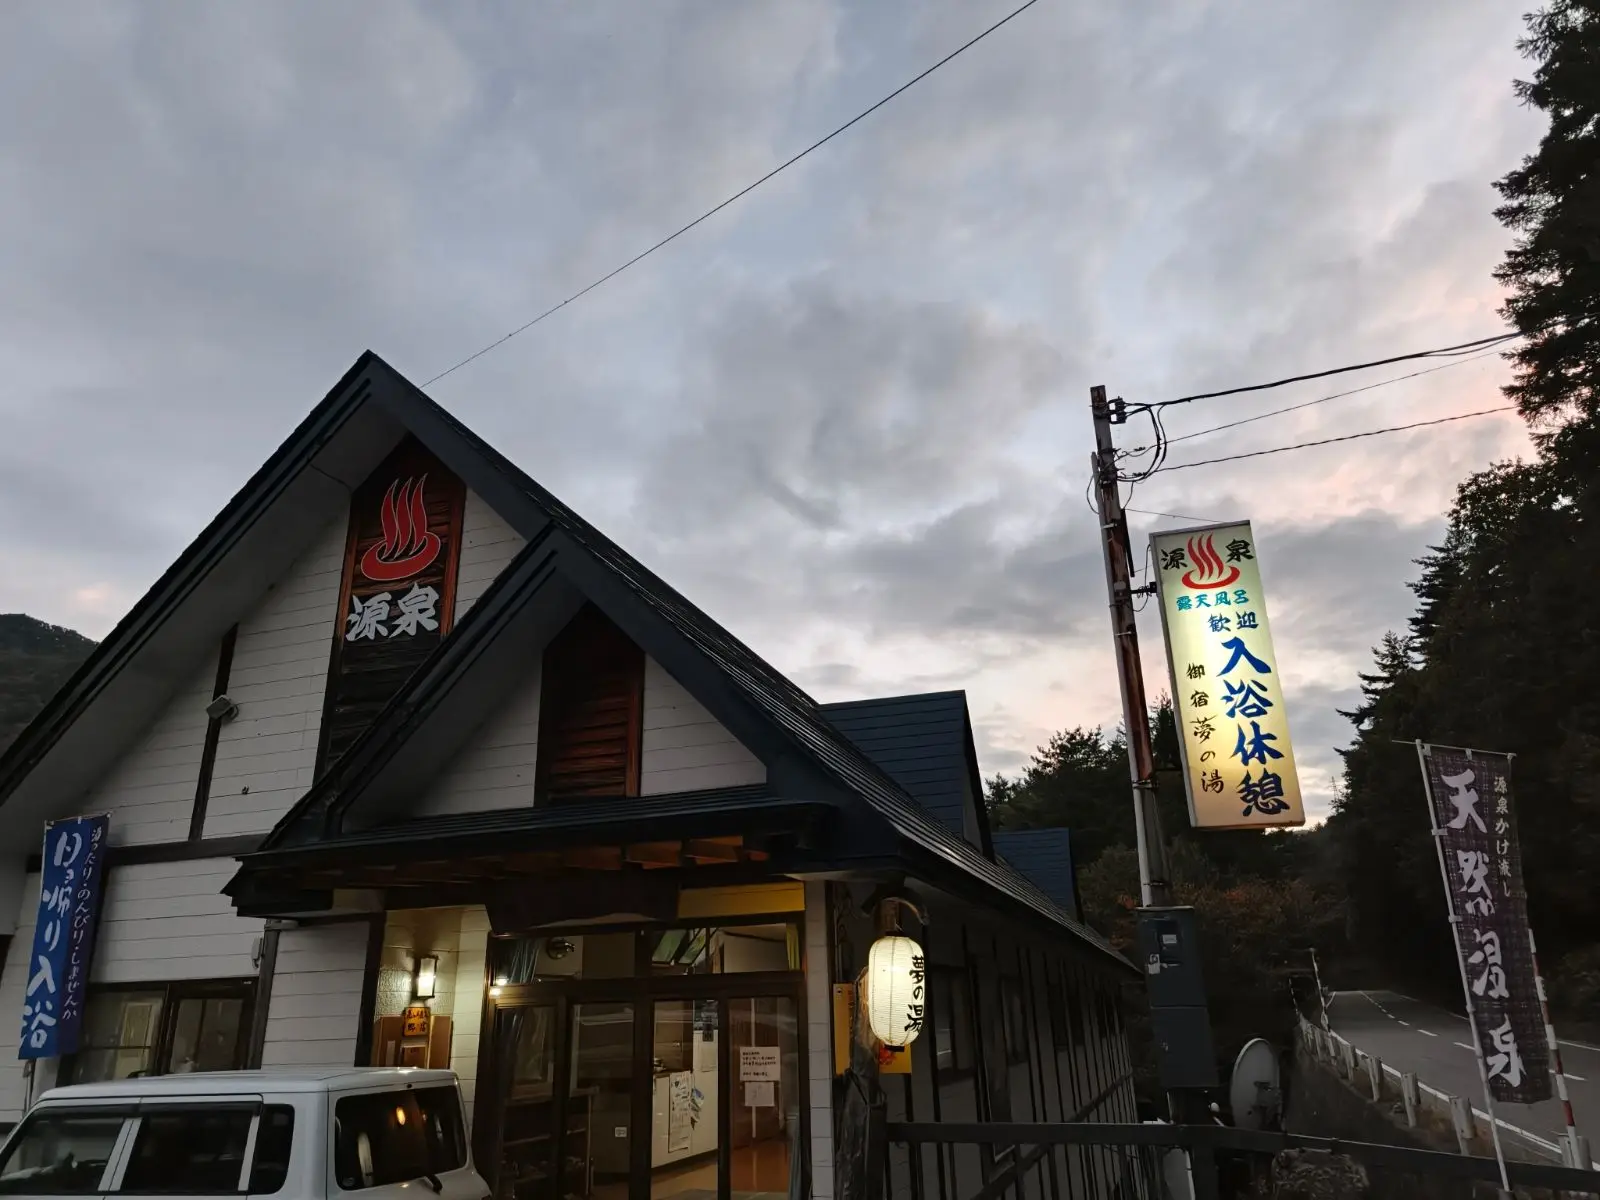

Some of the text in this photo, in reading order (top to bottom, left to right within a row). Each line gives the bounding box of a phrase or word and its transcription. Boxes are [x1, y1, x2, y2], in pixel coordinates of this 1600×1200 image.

[346, 582, 440, 641] 源泉
[1176, 589, 1250, 611] 露天風呂
[1208, 611, 1259, 632] 歓迎
[1186, 663, 1224, 793] 御宿夢の湯
[1216, 636, 1290, 817] 入浴休憩
[1494, 776, 1512, 897] 源泉かけ流し
[19, 832, 82, 1048] 日帰り入浴
[1441, 768, 1527, 1087] 天然温泉
